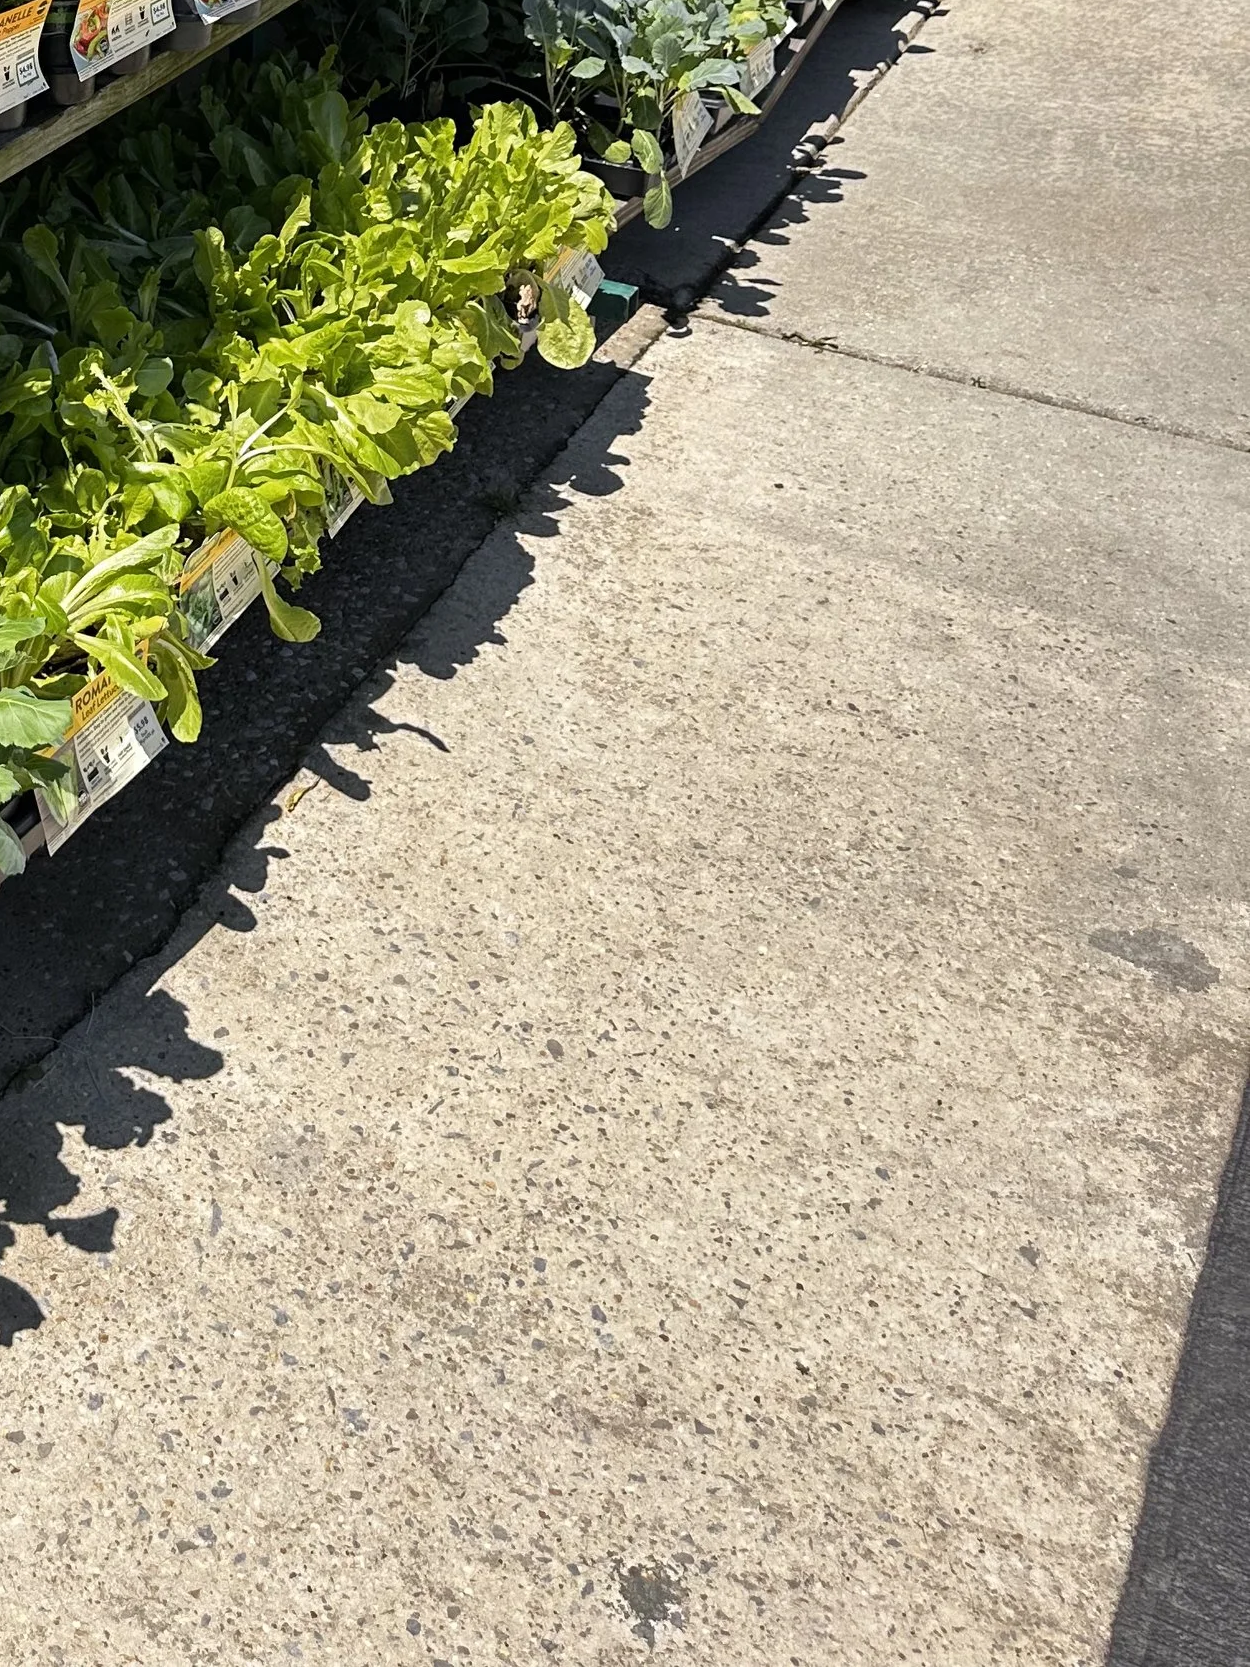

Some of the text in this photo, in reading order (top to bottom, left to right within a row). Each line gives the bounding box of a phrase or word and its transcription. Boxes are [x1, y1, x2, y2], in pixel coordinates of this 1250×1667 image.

[75, 677, 111, 714] ROMAI
[82, 684, 120, 721] Leaf Lettuc
